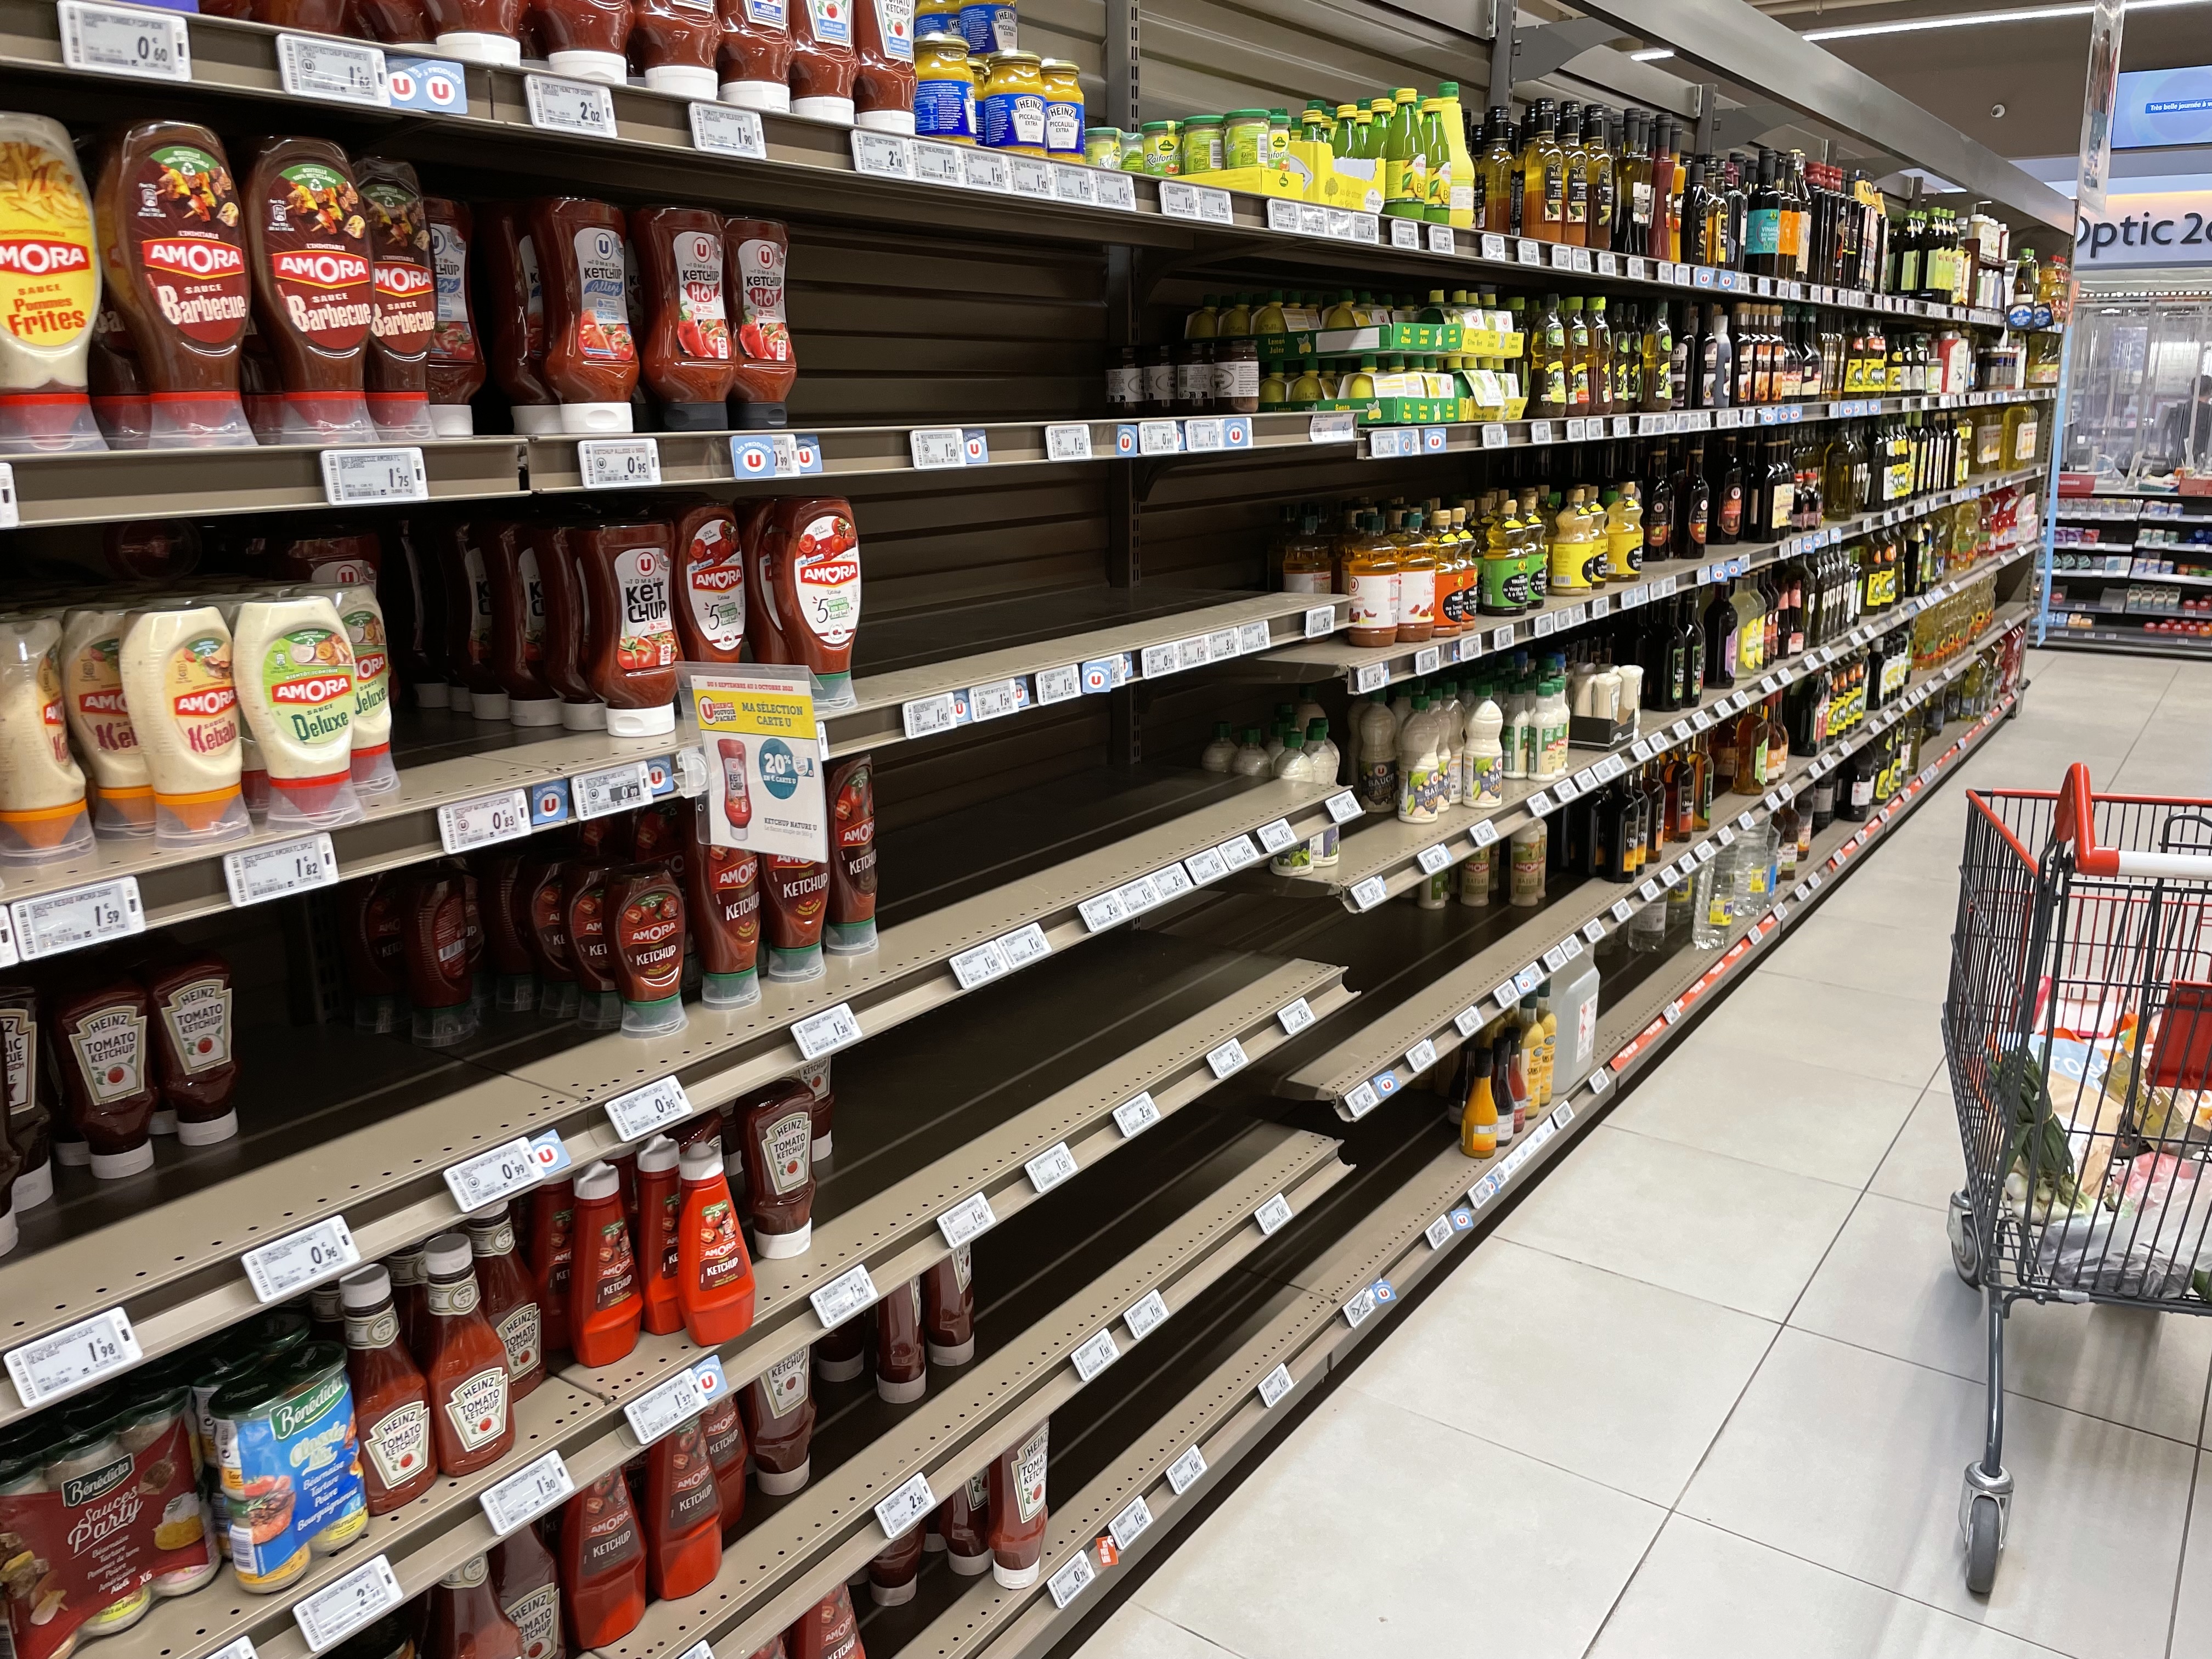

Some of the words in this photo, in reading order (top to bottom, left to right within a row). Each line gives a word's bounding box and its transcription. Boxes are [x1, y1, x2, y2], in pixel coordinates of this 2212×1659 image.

[886, 3, 910, 16] KETCHUP
[999, 11, 1016, 20] HEINZ
[432, 83, 449, 99] U
[1019, 99, 1041, 110] HEINZ
[1050, 108, 1074, 117] HEINZ
[2179, 101, 2201, 110] journée
[2180, 212, 2212, 245] 2
[151, 245, 240, 273] AMORA
[280, 256, 366, 283] AMORA
[18, 284, 61, 296] SAUCE
[184, 284, 223, 294] SAUCE
[375, 267, 431, 292] MORA
[312, 292, 349, 303] SAUCE
[691, 281, 716, 301] HOT
[754, 287, 778, 305] HOT
[156, 285, 246, 325] Barbecue
[287, 295, 371, 332] Barbecue
[387, 301, 417, 310] SAUCE
[7, 310, 87, 337] Frites
[371, 303, 435, 337] Barbecue
[1232, 431, 1240, 440] U
[744, 441, 772, 454] PRODUITS
[799, 451, 810, 463] U
[748, 454, 762, 467] U
[628, 600, 667, 623] CHUP
[708, 603, 720, 630] 5
[816, 598, 829, 623] 5
[285, 671, 312, 680] BIENTÔT
[359, 680, 377, 691] SAUCE
[1091, 675, 1102, 685] U
[276, 678, 349, 701] AMORA
[178, 689, 234, 714] AMORA
[307, 703, 333, 715] SAUCE
[742, 702, 754, 712] MA
[757, 701, 803, 715] SÉLECTION
[204, 718, 225, 729] SAUCE
[291, 712, 349, 741] Deluxe
[757, 716, 782, 726] CARTE
[785, 718, 792, 727] U
[188, 720, 237, 753] Kebab
[650, 771, 662, 784] U
[544, 798, 557, 812] U
[764, 817, 789, 827] KETCHUP
[790, 821, 811, 830] NATURE
[719, 860, 758, 884] AMORA
[783, 872, 828, 899] KETCHUP
[726, 891, 760, 921] KETCHUP
[632, 922, 676, 940] AMORA
[636, 945, 676, 966] KETCHUP
[181, 988, 215, 1006] HEINZ
[177, 1003, 224, 1024] TOMATO
[91, 1015, 128, 1034] HEINZ
[182, 1015, 223, 1035] KETCHUP
[85, 1031, 136, 1054] TOMATO
[91, 1044, 136, 1064] KETCHUP
[803, 1059, 827, 1075] KETCHUP
[777, 1120, 802, 1137] HEINZ
[774, 1133, 805, 1153] TOMATO
[777, 1142, 805, 1160] KETCHUP
[537, 1149, 554, 1164] U
[500, 1236, 510, 1247] 57
[704, 1240, 736, 1257] AMORA
[603, 1258, 630, 1276] AMORA
[707, 1257, 738, 1277] KETCHUP
[603, 1274, 632, 1296] KETCHUP
[459, 1292, 471, 1306] 57
[379, 1324, 391, 1339] 57
[506, 1312, 532, 1333] HEINZ
[504, 1323, 535, 1348] TOMATO
[508, 1332, 535, 1355] KETCHUP
[771, 1351, 805, 1378] KETCHUP
[463, 1377, 494, 1399] HEINZ
[701, 1375, 714, 1390] U
[276, 1376, 343, 1440] Bénédicta
[461, 1389, 500, 1415] TOMATO
[465, 1398, 499, 1422] KETCHUP
[383, 1411, 416, 1435] HEINZ
[708, 1410, 737, 1433] AMORA
[291, 1421, 347, 1466] Classic
[381, 1423, 421, 1450] TOMATO
[385, 1434, 420, 1458] KETCHUP
[709, 1429, 738, 1455] KETCHUP
[1027, 1432, 1048, 1457] HEINZ
[67, 1461, 129, 1507] Bénédicta
[303, 1461, 345, 1491] Béarnaise
[311, 1475, 339, 1497] Tartare
[678, 1465, 709, 1489] AMORA
[78, 1486, 137, 1528] Sauces
[315, 1487, 338, 1508] Poivre
[679, 1484, 712, 1512] KETCHUP
[297, 1487, 358, 1531] Bourguignonne
[67, 1498, 144, 1554] Party
[590, 1510, 629, 1534] AMORA
[92, 1535, 129, 1559] Béarnaise
[99, 1545, 126, 1563] Tartare
[593, 1530, 631, 1558] KETCHUP
[105, 1563, 127, 1579] Poivre
[139, 1570, 153, 1585] X6
[470, 1565, 481, 1580] 57
[511, 1595, 546, 1622] HEINZ
[521, 1608, 551, 1635] OMATO
[521, 1619, 552, 1644] ETCHUP
[827, 1633, 856, 1659] KETCHUP
